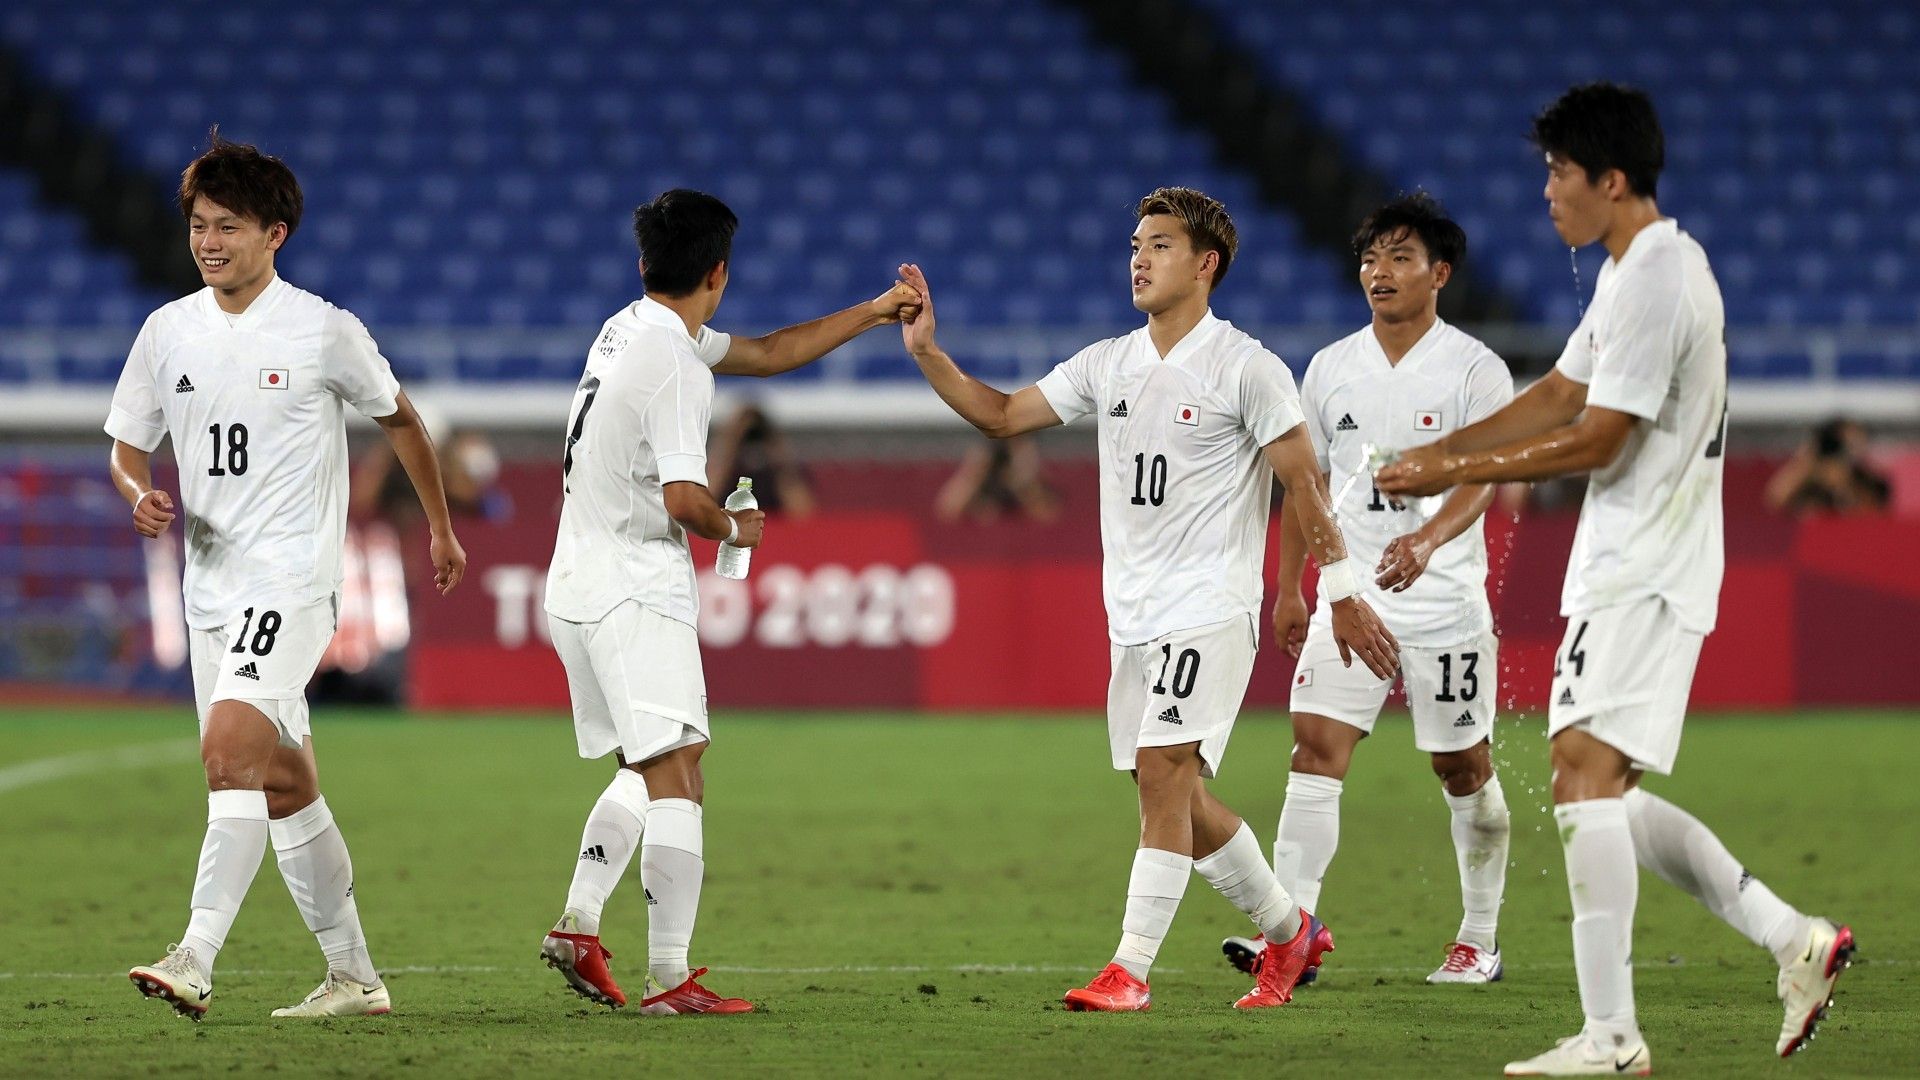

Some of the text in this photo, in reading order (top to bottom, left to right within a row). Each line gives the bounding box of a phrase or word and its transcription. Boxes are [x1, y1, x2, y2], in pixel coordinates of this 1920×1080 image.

[208, 423, 248, 476] 18
[1131, 452, 1167, 507] 10
[1366, 463, 1406, 512] 1
[756, 563, 957, 648] 2020
[230, 607, 282, 656] 18
[234, 670, 261, 681] adidas
[1152, 643, 1201, 699] 10
[1435, 652, 1479, 703] 13
[1158, 715, 1183, 726] adidas
